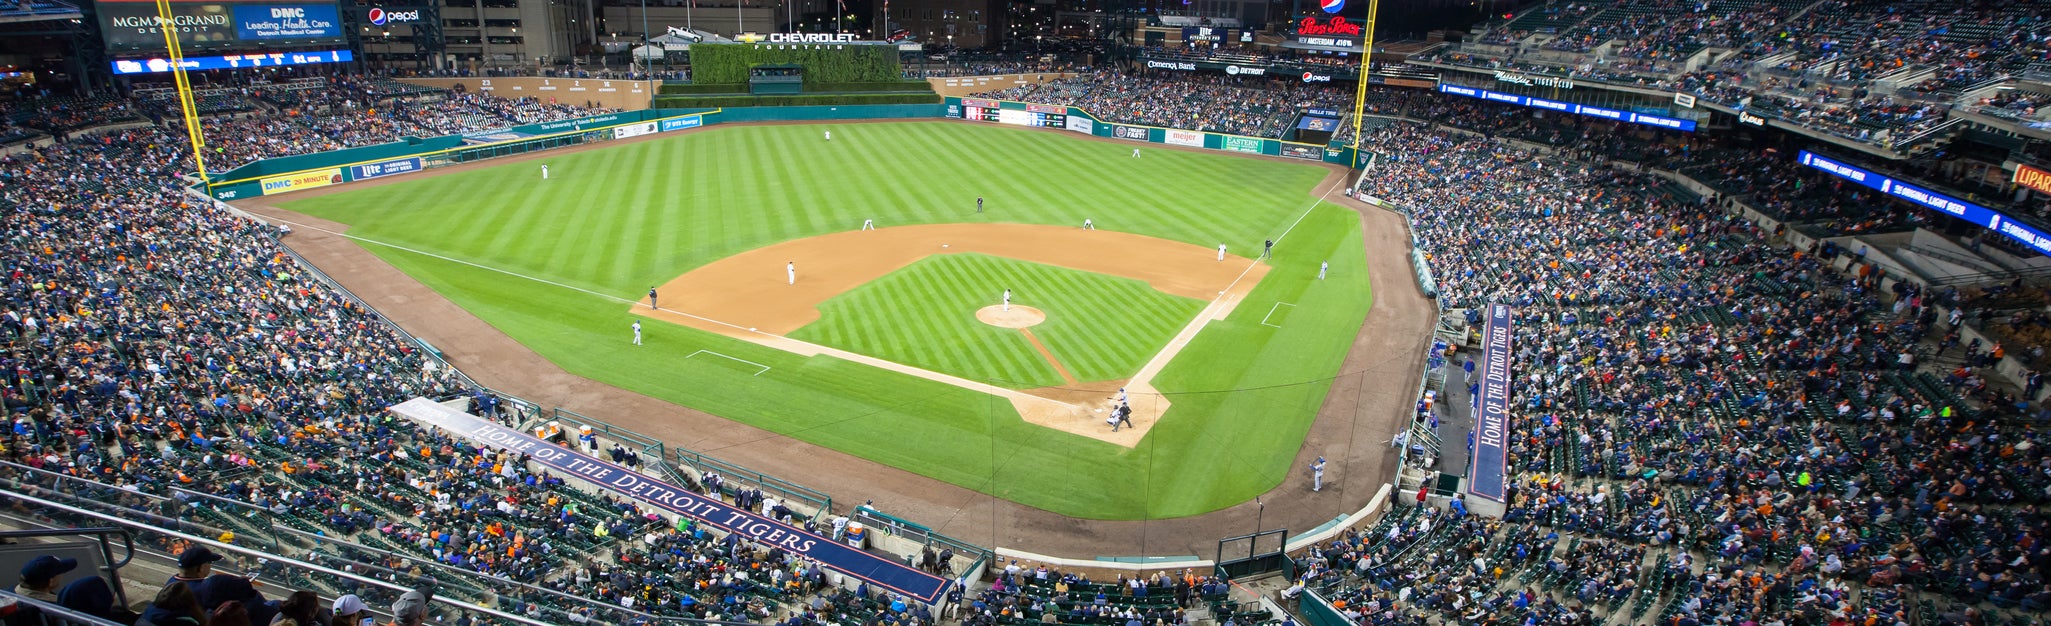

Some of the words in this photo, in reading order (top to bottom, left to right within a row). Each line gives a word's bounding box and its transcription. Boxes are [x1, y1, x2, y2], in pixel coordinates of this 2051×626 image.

[271, 8, 304, 18] DMC
[387, 9, 419, 22] pepsi
[113, 16, 154, 27] MGM
[174, 14, 226, 26] GRAND
[770, 33, 855, 43] CHEVROLET
[1178, 62, 1196, 71] Bank
[1126, 131, 1145, 139] FAST!
[1173, 132, 1196, 141] meijer
[1227, 136, 1259, 146] EASTERN
[389, 160, 412, 168] ORIGINAL
[362, 165, 381, 177] Lite
[1837, 165, 1853, 177] LIGHT
[1851, 170, 1866, 181] BEER
[265, 179, 292, 190] DMC
[303, 175, 329, 184] MINUTE
[218, 190, 237, 199] 345'
[1901, 187, 1928, 203] ORIGINAL
[1927, 196, 1949, 209] LIGHT
[1946, 201, 1967, 215] BEER
[1490, 326, 1507, 349] TIGERS
[1488, 349, 1506, 382] DETROIT
[1487, 382, 1503, 399] THE
[1487, 401, 1502, 414] OF
[1481, 416, 1501, 448] HOME
[472, 424, 534, 451] HOME
[535, 447, 563, 463] OF
[564, 458, 612, 480] THE
[611, 473, 721, 524] DETROIT
[730, 511, 818, 553] TIGERS
